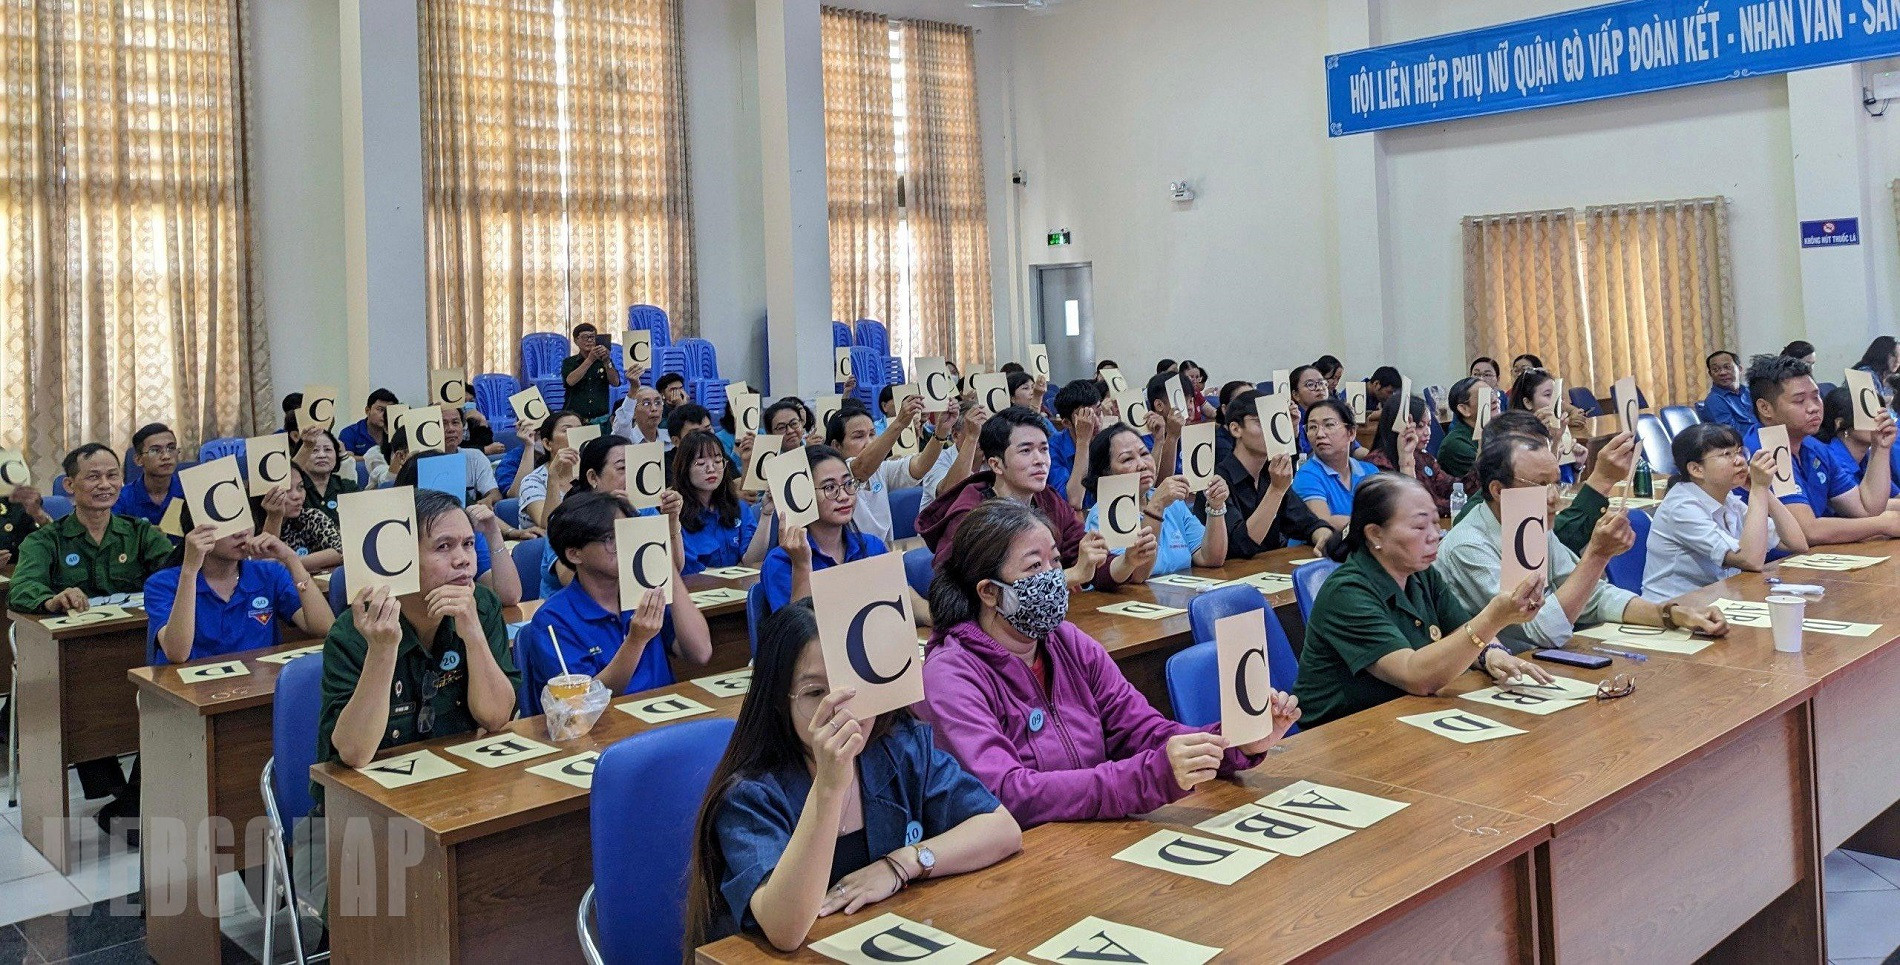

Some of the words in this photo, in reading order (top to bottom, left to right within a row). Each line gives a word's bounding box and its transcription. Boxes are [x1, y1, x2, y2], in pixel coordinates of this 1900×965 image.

[1350, 66, 1375, 118] HỘI
[1378, 60, 1411, 111] LIÊN
[1413, 53, 1449, 108] HIỆP
[1452, 53, 1483, 102] PHỤ
[1487, 40, 1510, 94] NỮ
[1514, 38, 1558, 97] QUẬN
[1561, 26, 1585, 82] GÒ
[1589, 18, 1624, 79] VẤP
[1628, 14, 1679, 72] ĐOÀN
[1683, 0, 1720, 63] KẾT
[630, 341, 649, 362] C
[1037, 355, 1048, 374] C
[841, 357, 850, 376] C
[442, 380, 464, 402] C
[926, 372, 947, 400] C
[309, 398, 335, 422] C
[524, 397, 546, 420] C
[987, 387, 1009, 413] C
[1352, 394, 1363, 414] C
[1860, 387, 1880, 418] C
[743, 407, 758, 430] C
[1128, 403, 1147, 426] C
[416, 421, 440, 447] C
[898, 424, 914, 448] C
[1271, 412, 1291, 444] C
[0, 460, 30, 486] C
[259, 451, 288, 482] C
[1191, 443, 1212, 477] C
[1773, 446, 1790, 481] C
[636, 461, 662, 497] C
[784, 469, 813, 513] C
[204, 478, 245, 522] C
[1108, 494, 1136, 535] C
[362, 517, 413, 576] C
[1515, 516, 1545, 570] C
[632, 541, 668, 588] C
[1803, 620, 1852, 631] D
[847, 595, 911, 685] C
[195, 664, 234, 675] D
[443, 655, 456, 666] 20
[1235, 648, 1269, 716] C
[643, 700, 697, 714] D
[1491, 690, 1550, 704] B
[1032, 713, 1041, 726] 09
[1433, 715, 1496, 732] D
[476, 740, 538, 757] B
[367, 759, 420, 776] A
[1279, 789, 1351, 811] A
[906, 827, 919, 843] 10
[1234, 812, 1316, 840] B
[1158, 837, 1239, 865] D
[861, 923, 956, 962] D
[1057, 931, 1148, 964] A
